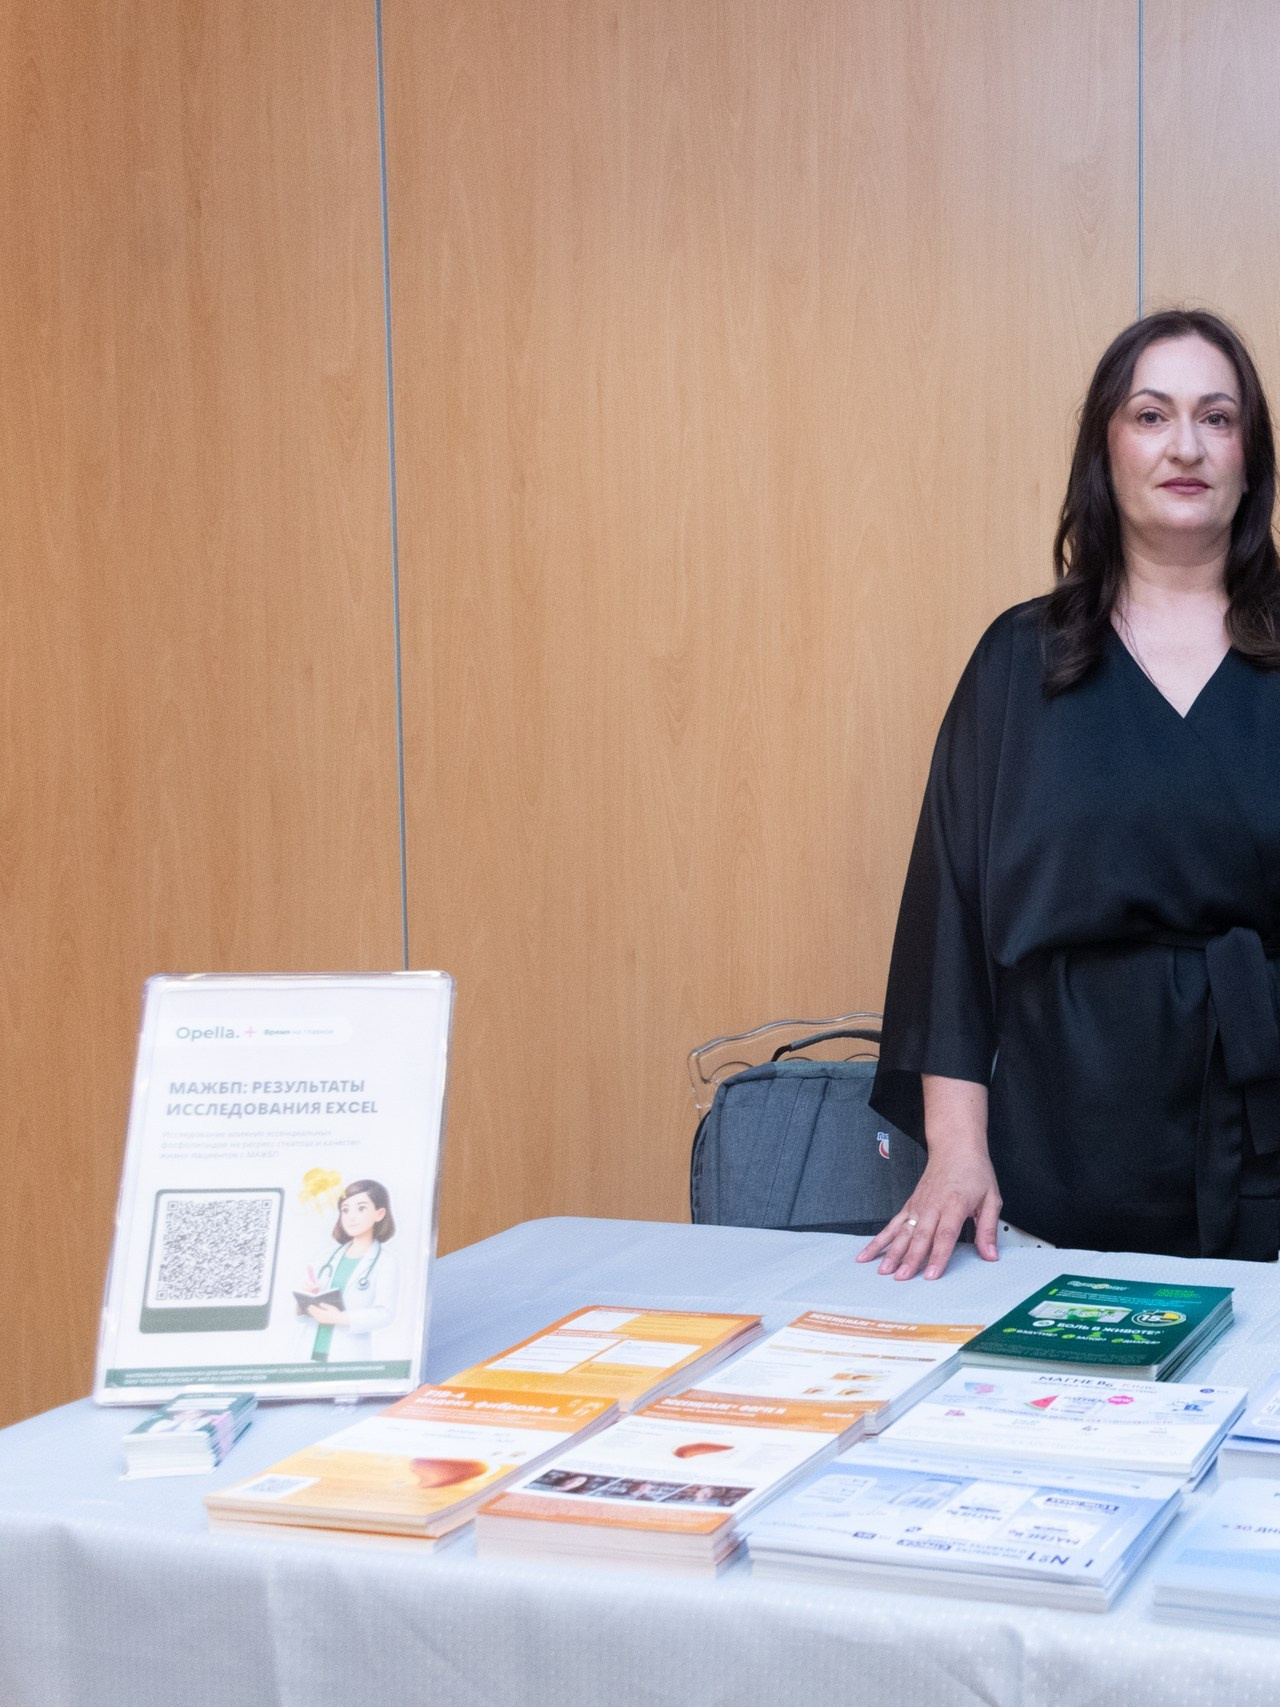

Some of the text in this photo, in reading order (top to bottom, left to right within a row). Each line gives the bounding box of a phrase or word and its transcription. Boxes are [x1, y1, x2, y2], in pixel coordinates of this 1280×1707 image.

[175, 1026, 240, 1042] Opella.
[263, 1028, 290, 1038] Время
[168, 1079, 366, 1096] МАЖБП: РЕЗУЛЬТАТЫ
[166, 1100, 379, 1119] ИССЛЕДОВАНИЯ EXCEL
[1056, 1322, 1090, 1332] БОЛЬ
[424, 1390, 467, 1400] FIB-4
